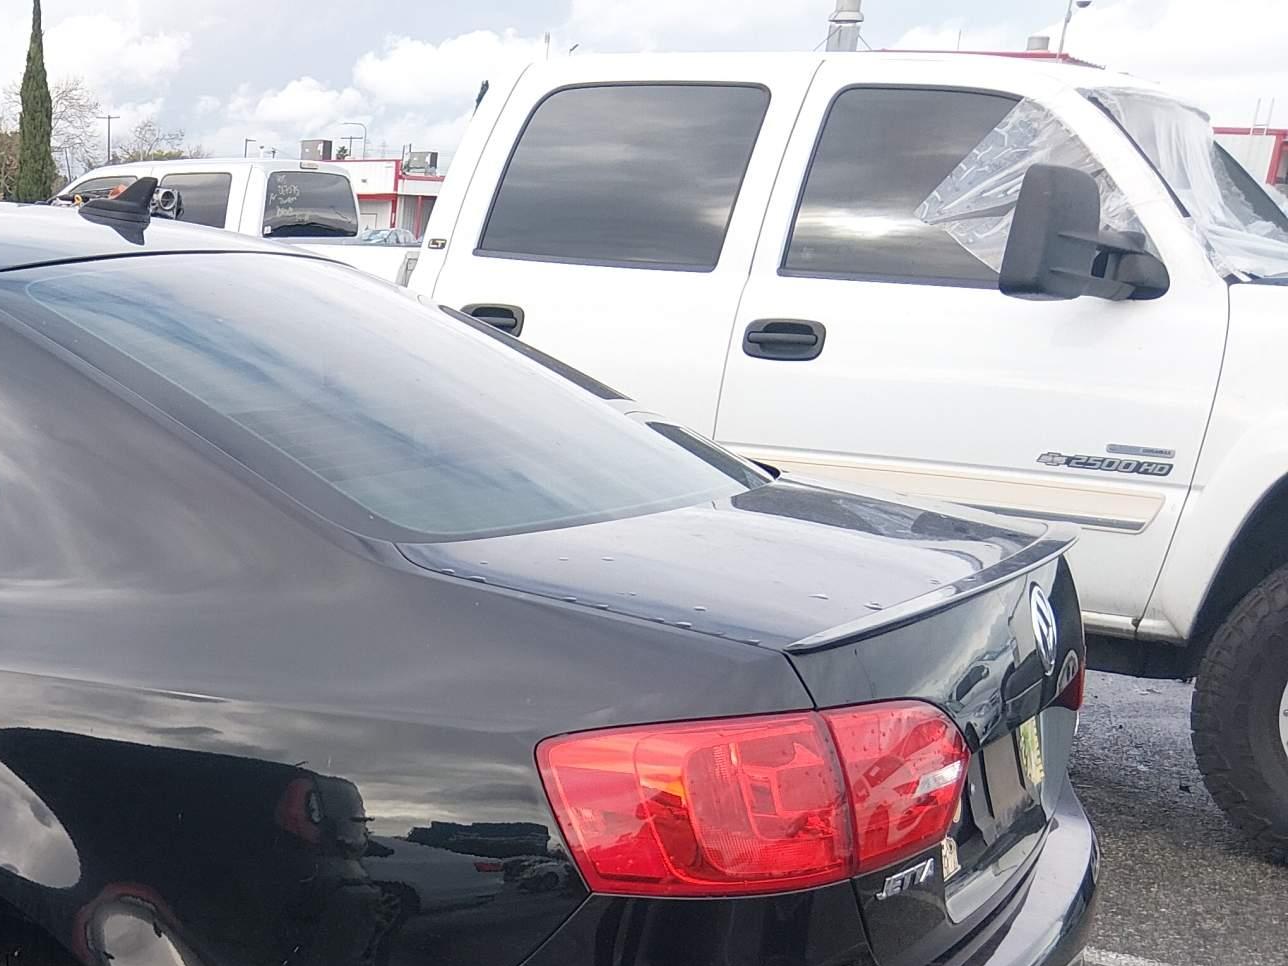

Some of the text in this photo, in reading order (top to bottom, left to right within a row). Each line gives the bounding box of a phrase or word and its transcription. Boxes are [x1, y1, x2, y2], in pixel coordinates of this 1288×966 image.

[429, 239, 446, 248] LT
[1069, 454, 1171, 475] 2500 HD
[876, 858, 935, 900] JETTA
